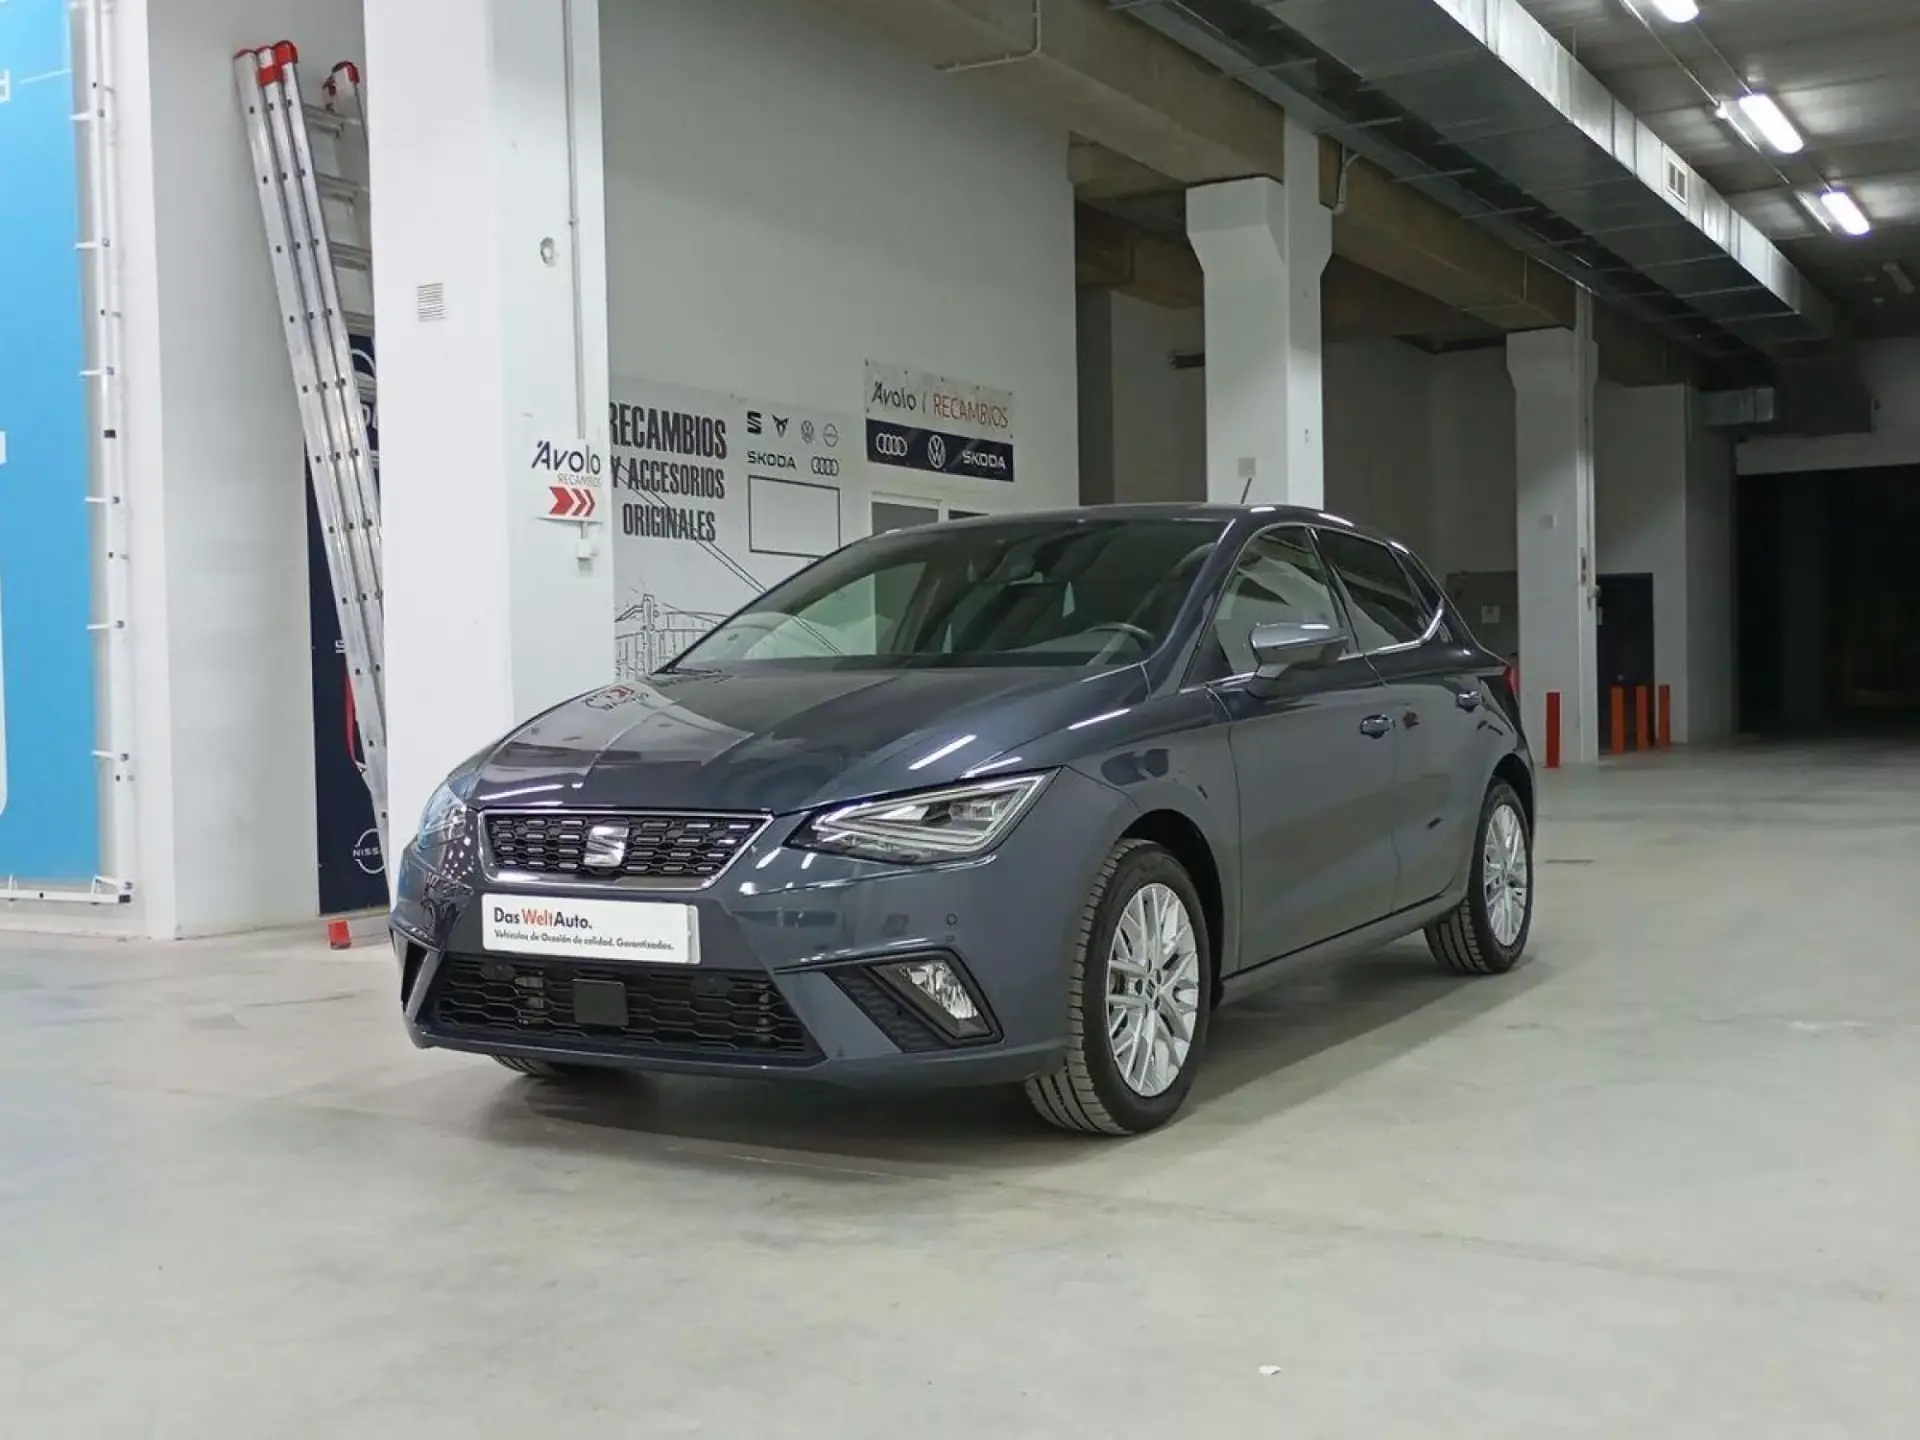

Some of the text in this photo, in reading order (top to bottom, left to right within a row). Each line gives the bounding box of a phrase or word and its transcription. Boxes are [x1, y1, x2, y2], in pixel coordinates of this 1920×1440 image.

[932, 392, 1009, 429] RECAMBIOS
[747, 450, 797, 471] SKODA
[962, 450, 1007, 469] SKODA
[610, 455, 726, 500] Y ACCESORIOS
[623, 503, 716, 541] ORIGINALES
[494, 907, 520, 925] Das
[530, 931, 540, 941] de
[573, 935, 582, 944] de
